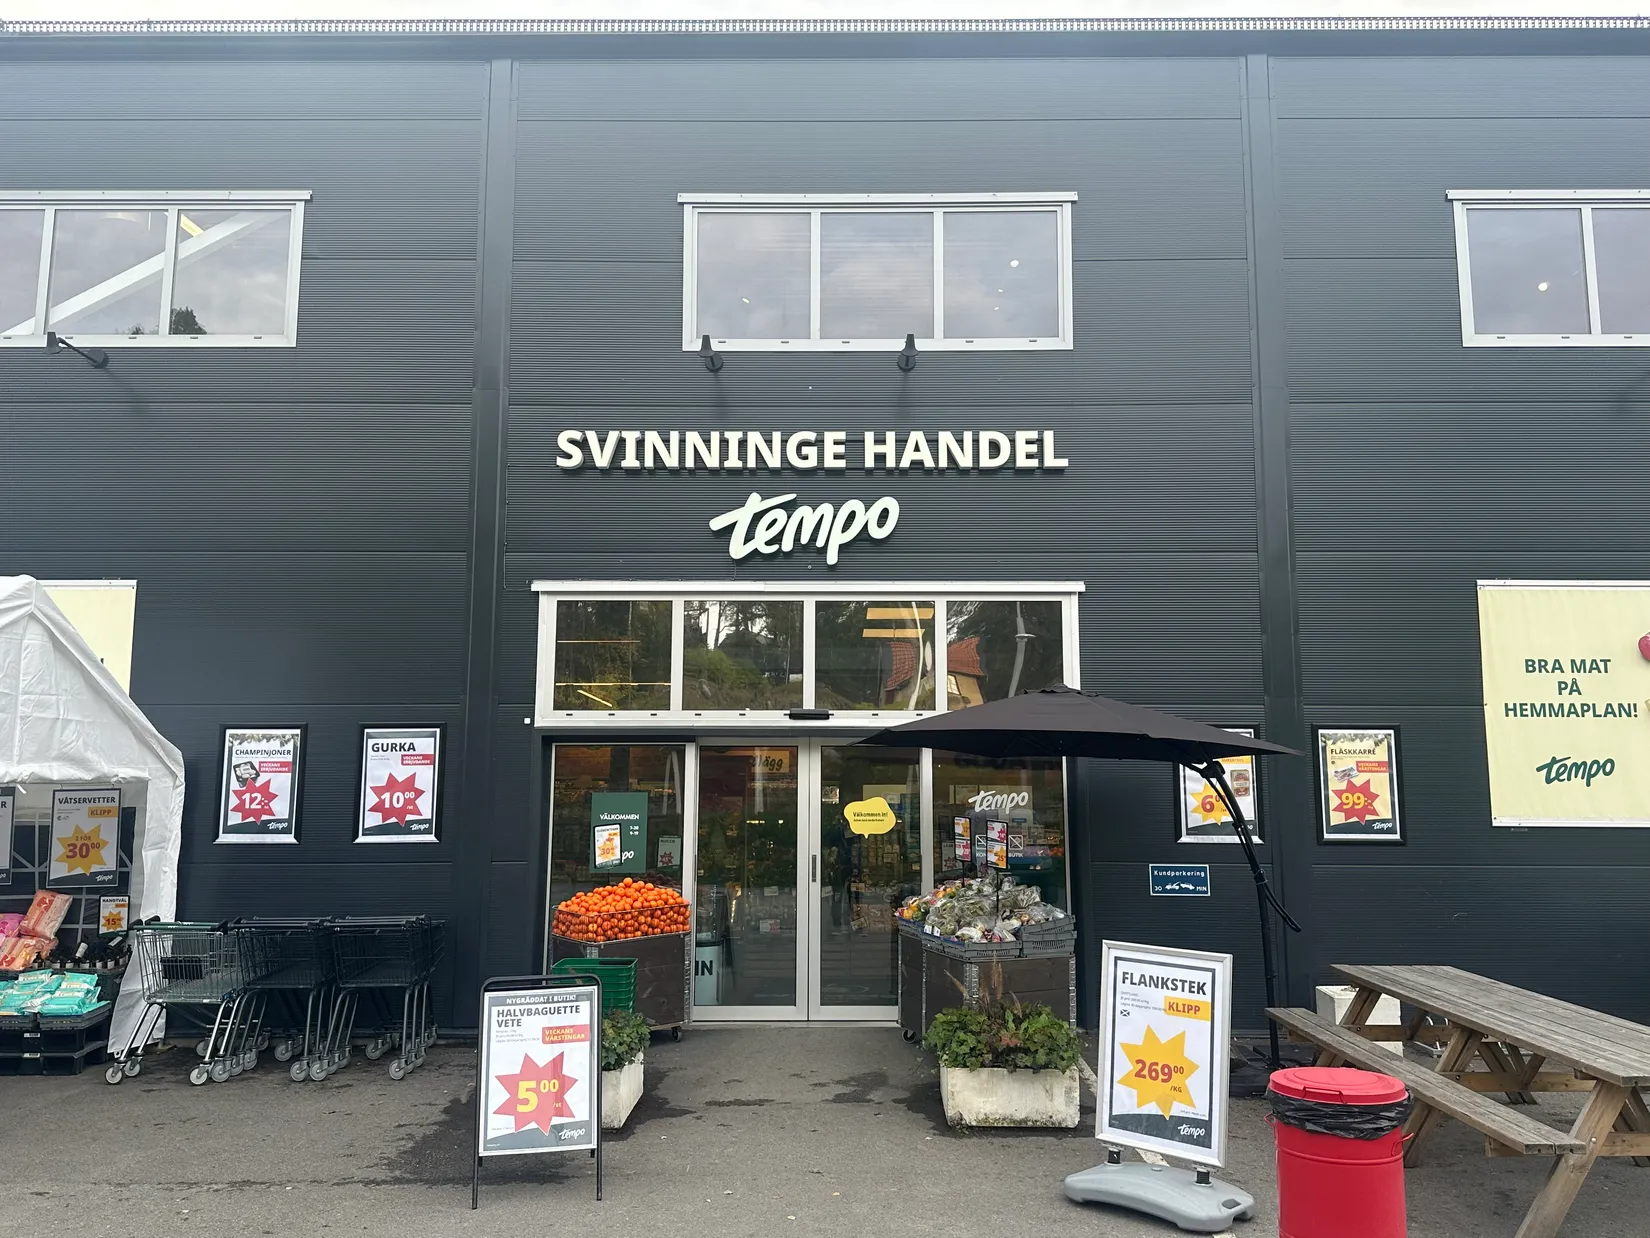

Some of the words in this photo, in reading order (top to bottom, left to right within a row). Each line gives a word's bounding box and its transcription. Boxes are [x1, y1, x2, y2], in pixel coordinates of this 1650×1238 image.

[556, 429, 846, 470] SVINNINGE
[864, 429, 1069, 470] HANDEL
[709, 492, 900, 565] tempo
[1525, 658, 1565, 674] BRA
[1570, 658, 1612, 674] MAT
[1557, 677, 1582, 695] PÅ
[1504, 702, 1638, 718] HEMMAPLAN!
[235, 749, 292, 757] CHAMPINJONER
[371, 742, 416, 752] GURKA
[1330, 748, 1376, 756] FLÄSKKARRÉ
[1536, 756, 1616, 788] tempo
[58, 796, 116, 804] VÅTSERVETTER
[968, 790, 1028, 814] tempo
[266, 822, 288, 830] tempo
[1372, 822, 1392, 830] tempo
[1122, 971, 1207, 996] FLANKSTEK
[506, 996, 548, 1004] NYGRÄDDAT
[497, 1005, 580, 1018] HALVBAGUETTE
[1168, 1001, 1200, 1015] KLIPP
[496, 1018, 522, 1028] VETE
[545, 1033, 585, 1041] VÄRSTINGAR
[1170, 1085, 1182, 1093] /KG
[558, 1128, 586, 1140] tempo
[1178, 1124, 1205, 1139] tempo
